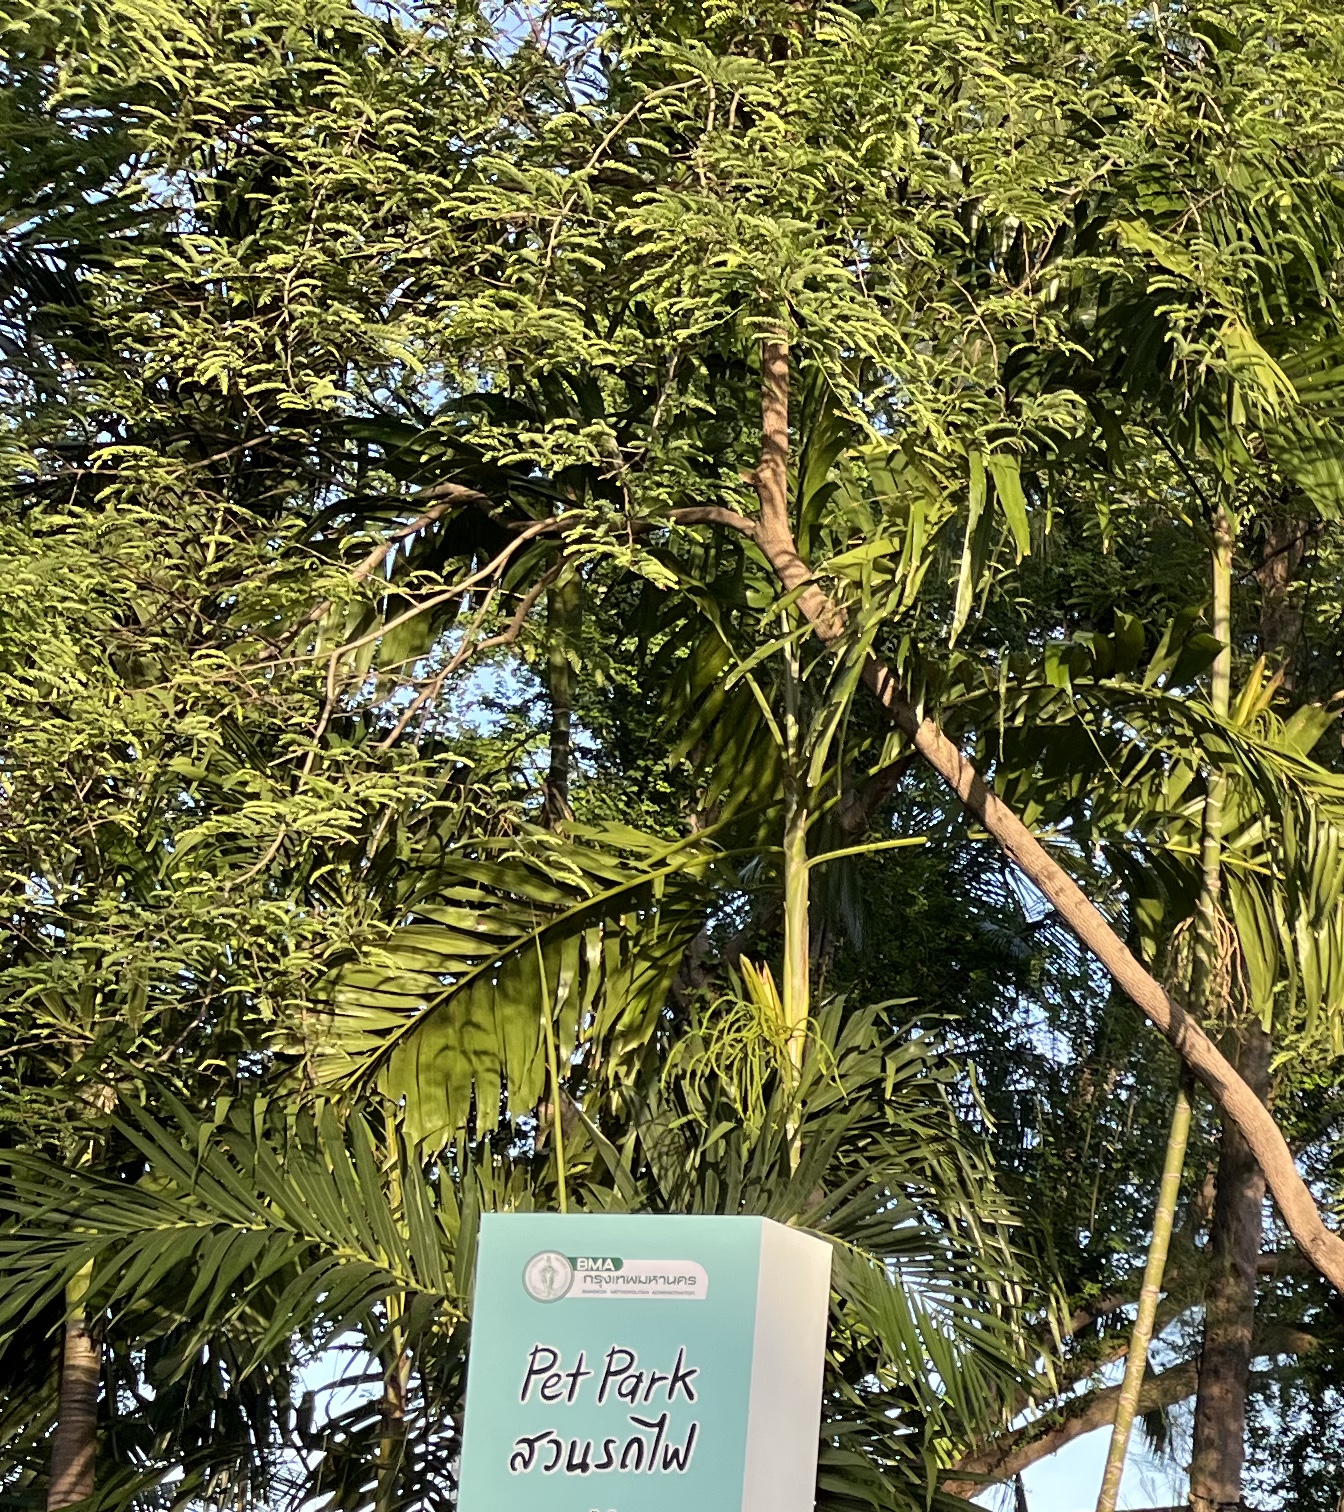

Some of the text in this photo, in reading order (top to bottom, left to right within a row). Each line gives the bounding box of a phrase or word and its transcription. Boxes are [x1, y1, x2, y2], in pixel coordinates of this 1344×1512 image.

[577, 1257, 615, 1271] BMA
[583, 1273, 697, 1288] กรุงเทพมหานคร
[520, 1344, 698, 1404] Pet Park
[509, 1412, 698, 1474] สวนรถไฟ
